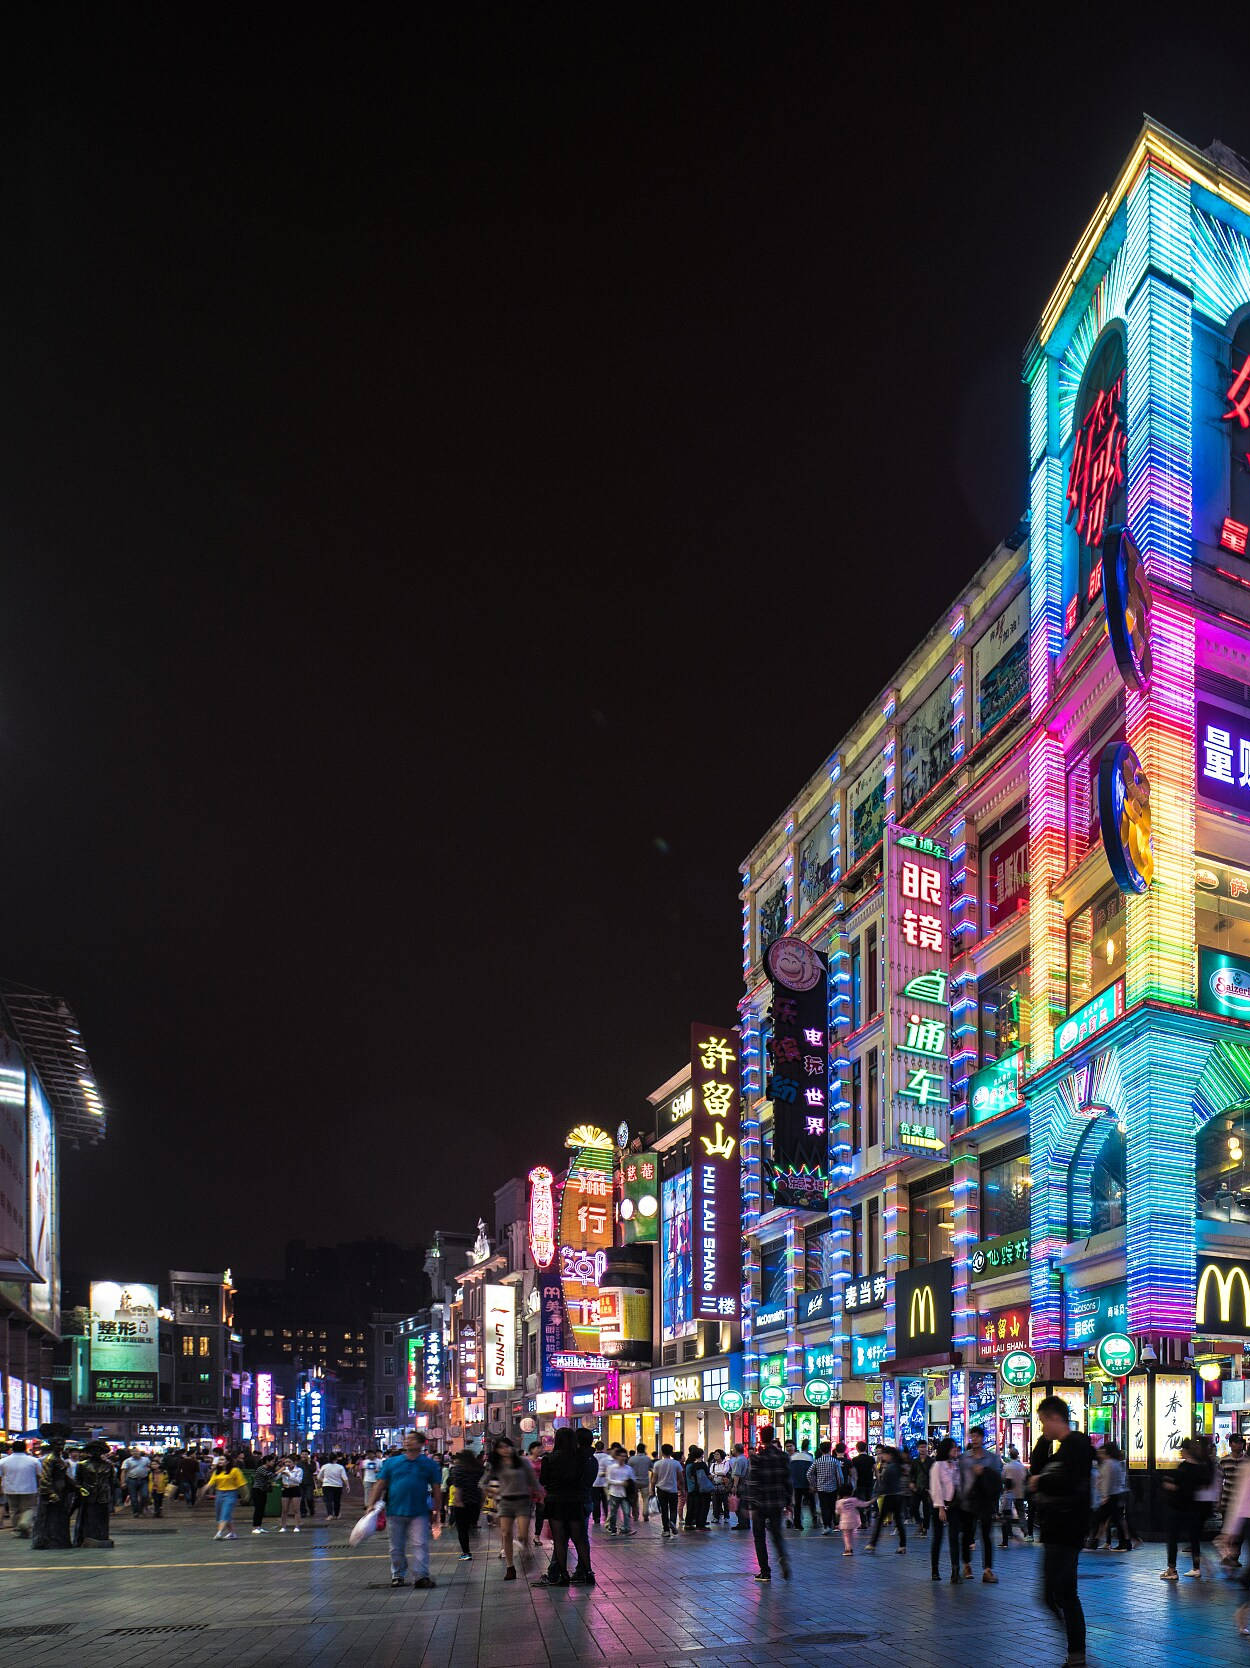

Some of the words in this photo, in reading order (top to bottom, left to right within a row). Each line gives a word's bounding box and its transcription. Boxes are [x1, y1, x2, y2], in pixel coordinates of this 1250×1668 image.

[698, 1036, 737, 1160] 許留山
[803, 1026, 825, 1137] 电玩世界
[703, 1165, 716, 1194] HUI
[703, 1200, 716, 1233] LAU
[845, 1276, 887, 1309] 麦当劳
[495, 1323, 505, 1377] LI-NING
[1006, 1341, 1024, 1352] SHAN
